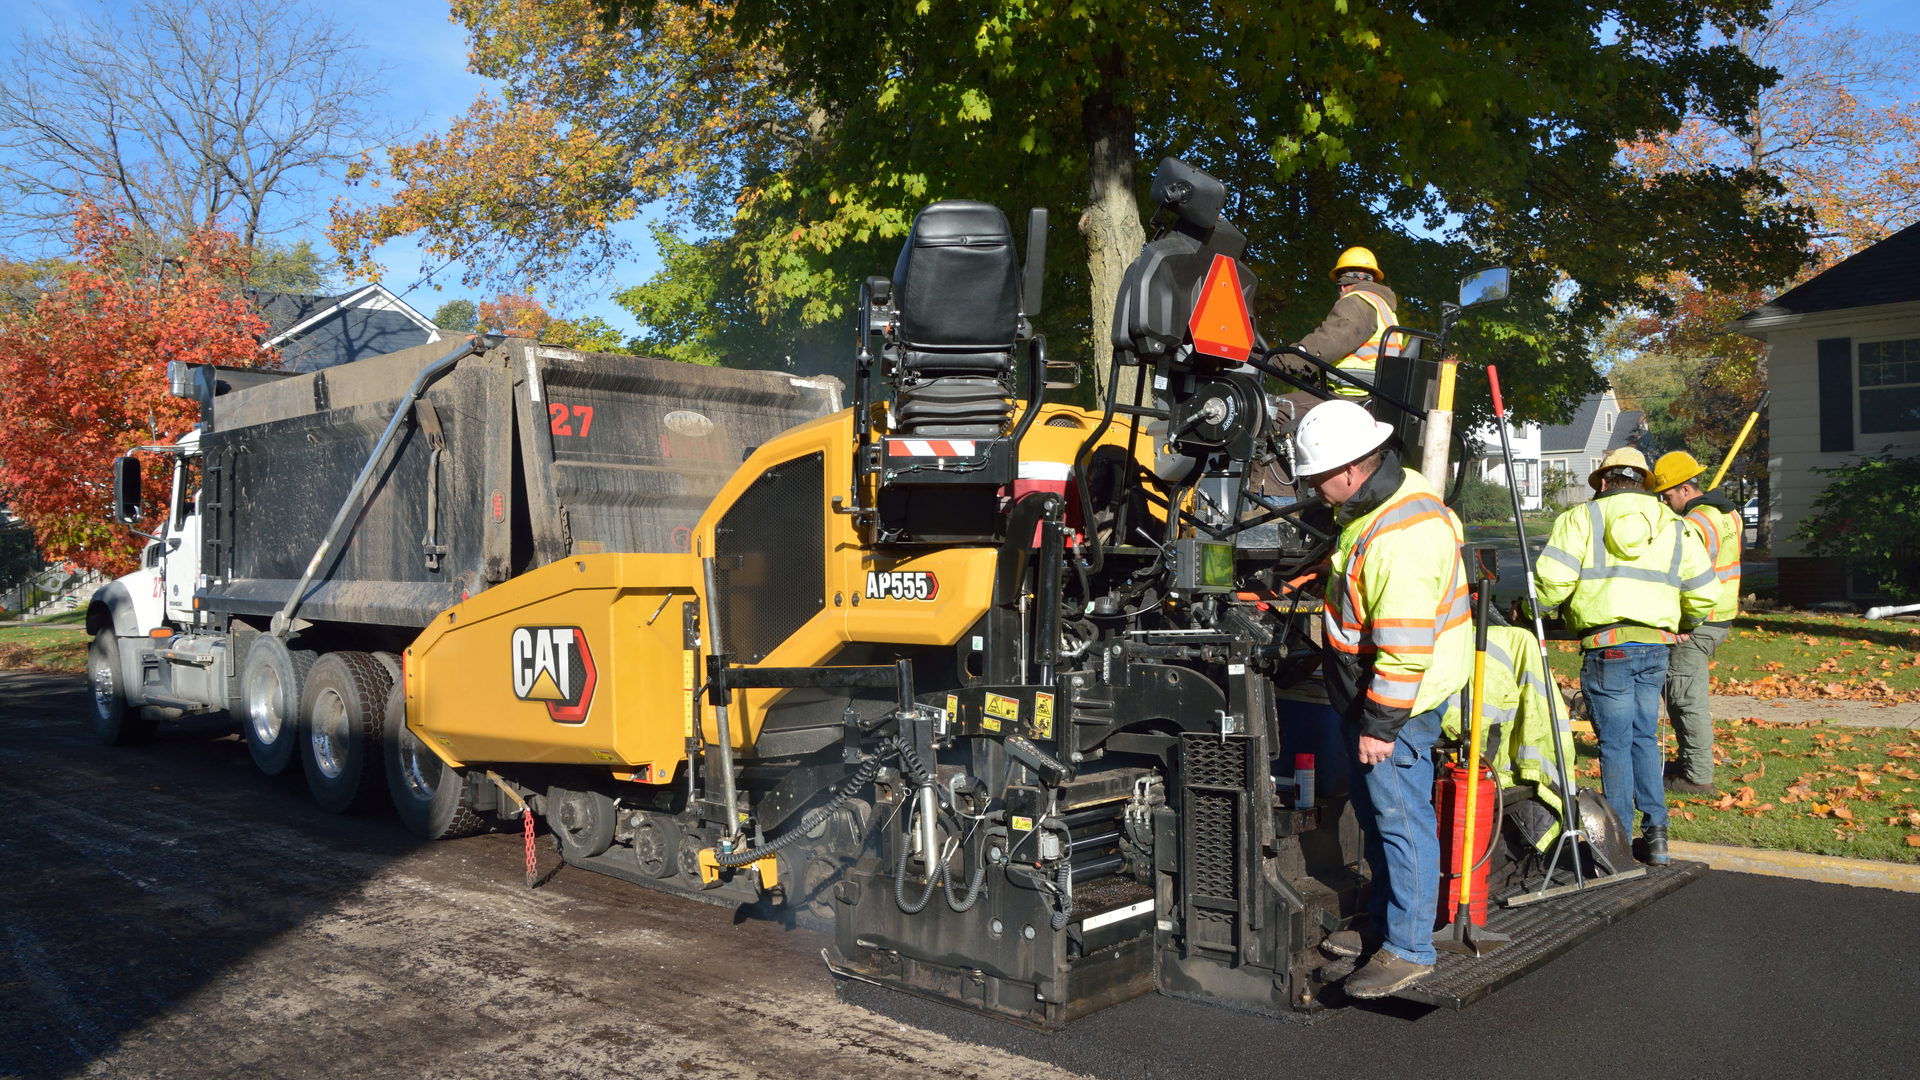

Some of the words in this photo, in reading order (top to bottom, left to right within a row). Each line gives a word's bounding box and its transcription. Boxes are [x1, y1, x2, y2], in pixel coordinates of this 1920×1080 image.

[548, 403, 593, 438] 27
[152, 576, 163, 598] 27
[866, 572, 928, 600] AP555
[512, 628, 574, 701] CAT
